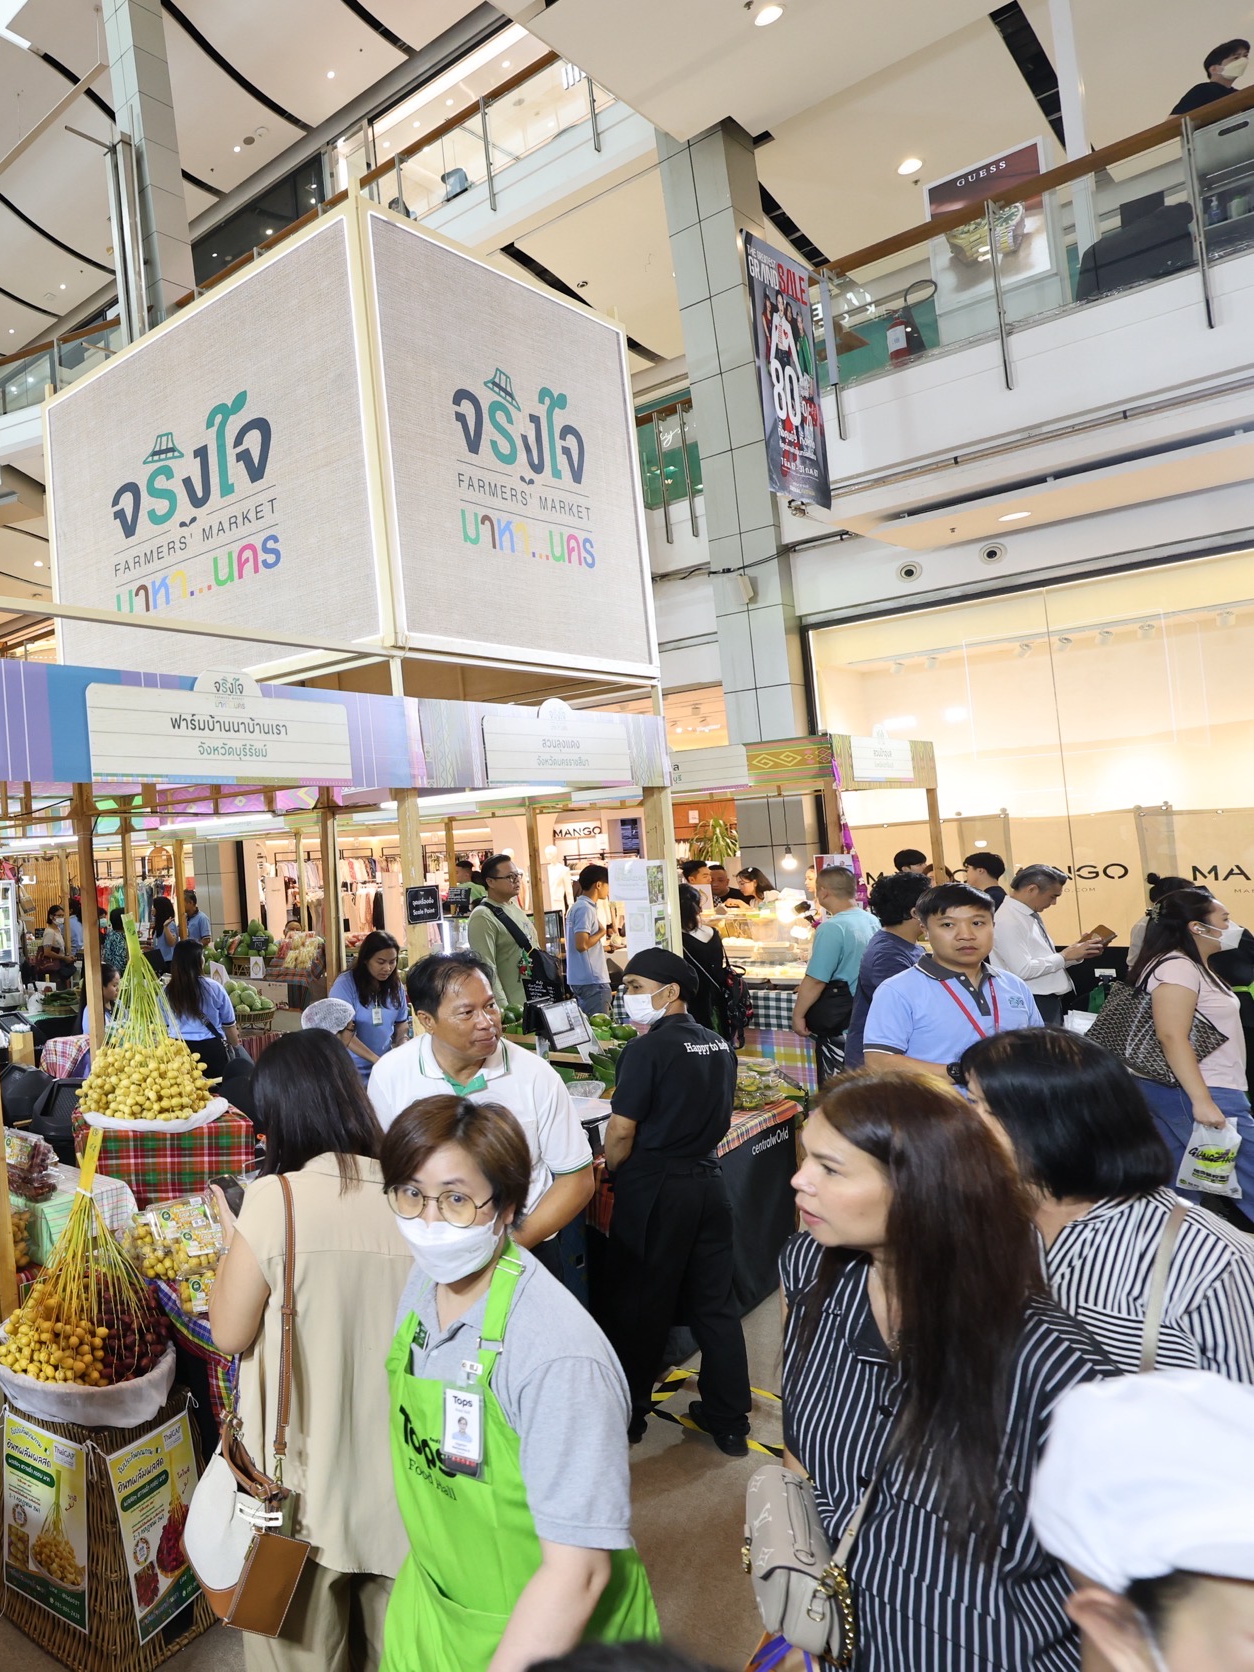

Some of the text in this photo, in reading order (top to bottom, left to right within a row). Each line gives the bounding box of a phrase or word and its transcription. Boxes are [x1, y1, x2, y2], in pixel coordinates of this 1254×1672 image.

[957, 160, 1008, 187] GUESS
[748, 255, 808, 306] GRAND SALE
[457, 473, 592, 521] FARMERS' MARKET
[114, 497, 278, 578] FARMERS' MARKET
[170, 713, 288, 736] ฟาร์มบ้านนาบ้านเรา
[553, 826, 602, 838] MANGO
[684, 1041, 710, 1055] Happy
[751, 1125, 790, 1156] centralwOrld
[452, 1395, 473, 1408] Tops
[408, 1457, 434, 1486] Food
